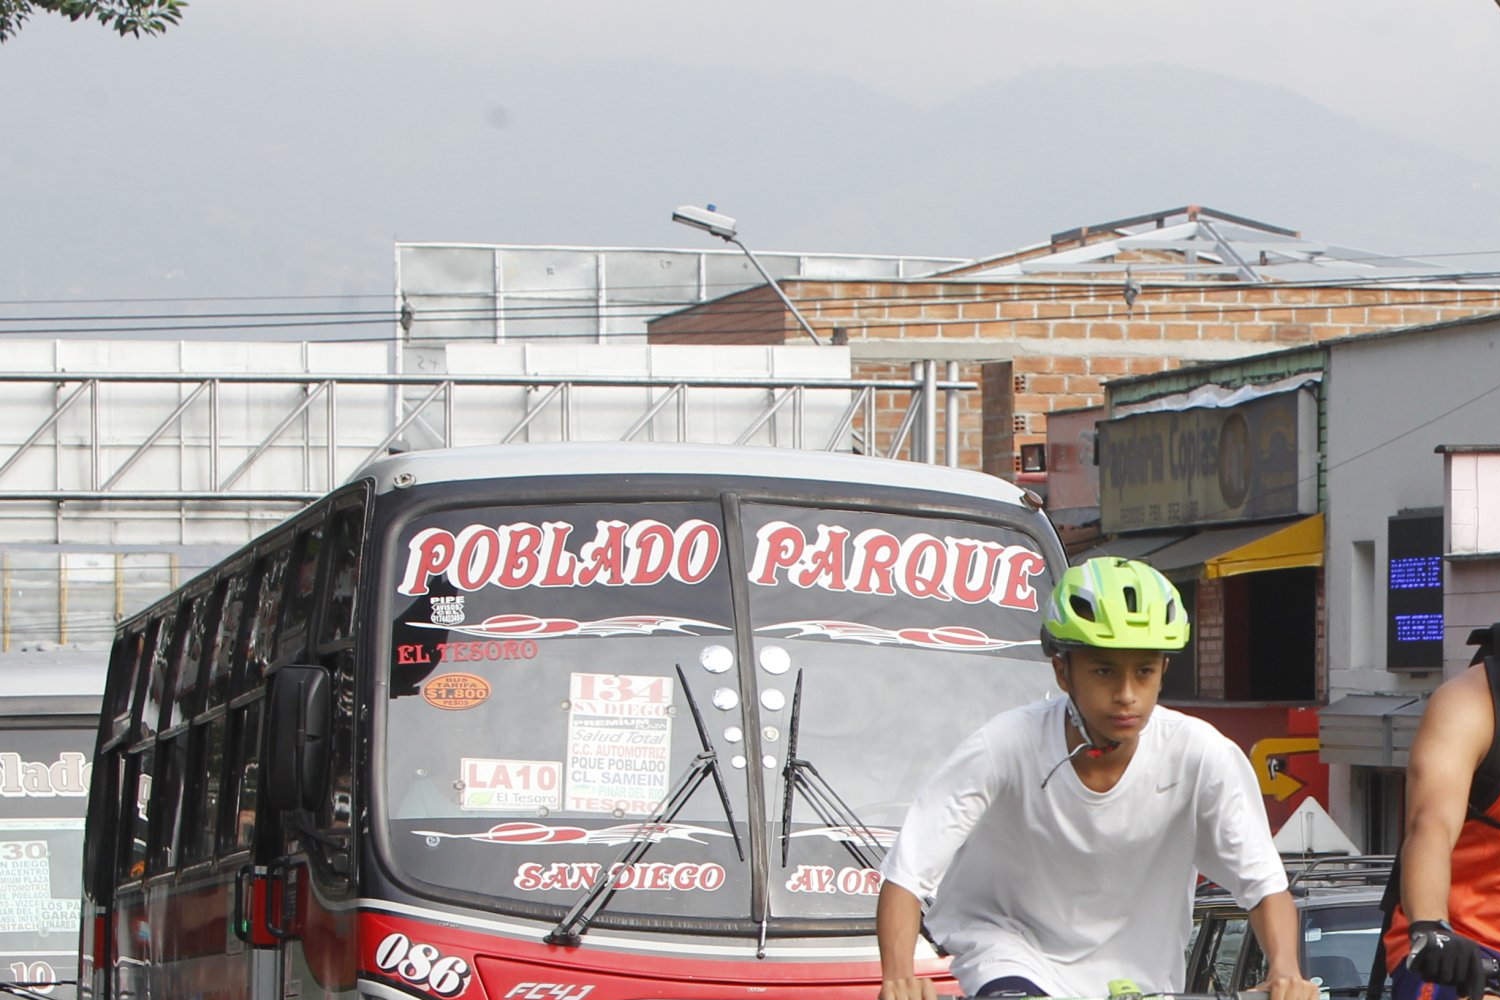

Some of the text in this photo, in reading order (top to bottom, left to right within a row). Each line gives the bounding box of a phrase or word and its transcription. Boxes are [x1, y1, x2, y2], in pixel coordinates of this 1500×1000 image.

[397, 519, 1047, 612] POBLADO PARQUE
[430, 596, 466, 605] PIPE
[398, 639, 539, 665] EL TESORO
[426, 689, 487, 699] $1.800
[571, 675, 669, 704] 134
[573, 702, 667, 717] SN DIEGO
[572, 729, 666, 745] Salud Total
[596, 745, 667, 759] AUTOMOTRIZ
[571, 757, 666, 772] PQUE POBLADO
[571, 771, 665, 787] CL. SAMEIN
[513, 793, 557, 803] Tesoro
[571, 797, 664, 813] TESORO
[514, 862, 725, 891] SAN DIEGO
[785, 864, 837, 894] AV.
[41, 902, 63, 911] LOS
[375, 932, 471, 998] 086
[11, 961, 56, 994] 10
